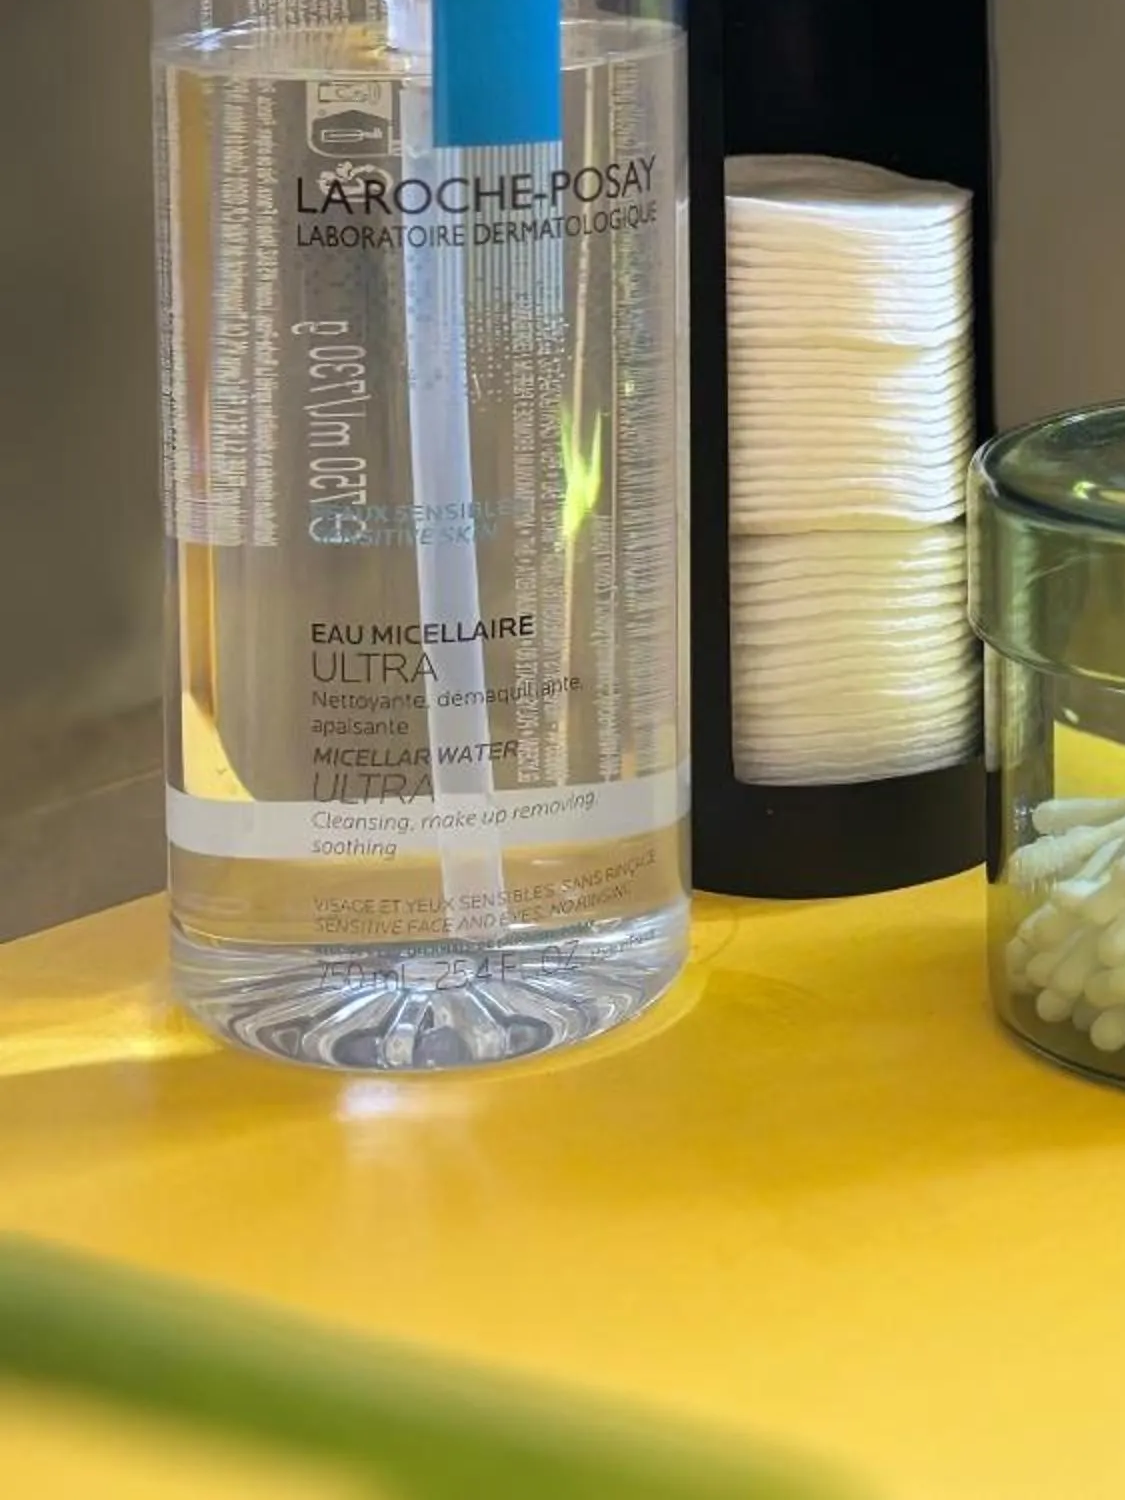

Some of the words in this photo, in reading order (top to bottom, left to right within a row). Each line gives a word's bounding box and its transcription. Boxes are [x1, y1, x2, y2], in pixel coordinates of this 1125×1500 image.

[296, 177, 354, 215] LA
[363, 154, 657, 215] ROCHE-POSAY
[296, 224, 466, 250] LABORATOIRE
[473, 200, 658, 246] DERMATOLOGIQUE
[311, 622, 364, 646] EAU
[371, 614, 536, 646] MICELLAIRE
[311, 651, 439, 684] ULTRA
[311, 716, 410, 737] apaisante
[312, 746, 433, 768] MICELLAR
[437, 739, 520, 766] WATER
[312, 771, 436, 806] ULTRA
[421, 810, 478, 831] make
[480, 808, 507, 827] up
[311, 837, 399, 862] soothing
[312, 896, 376, 916] VISAGE
[380, 898, 402, 915] ET
[404, 897, 455, 915] YEUX
[406, 916, 452, 935] FACE
[456, 911, 497, 933] AND
